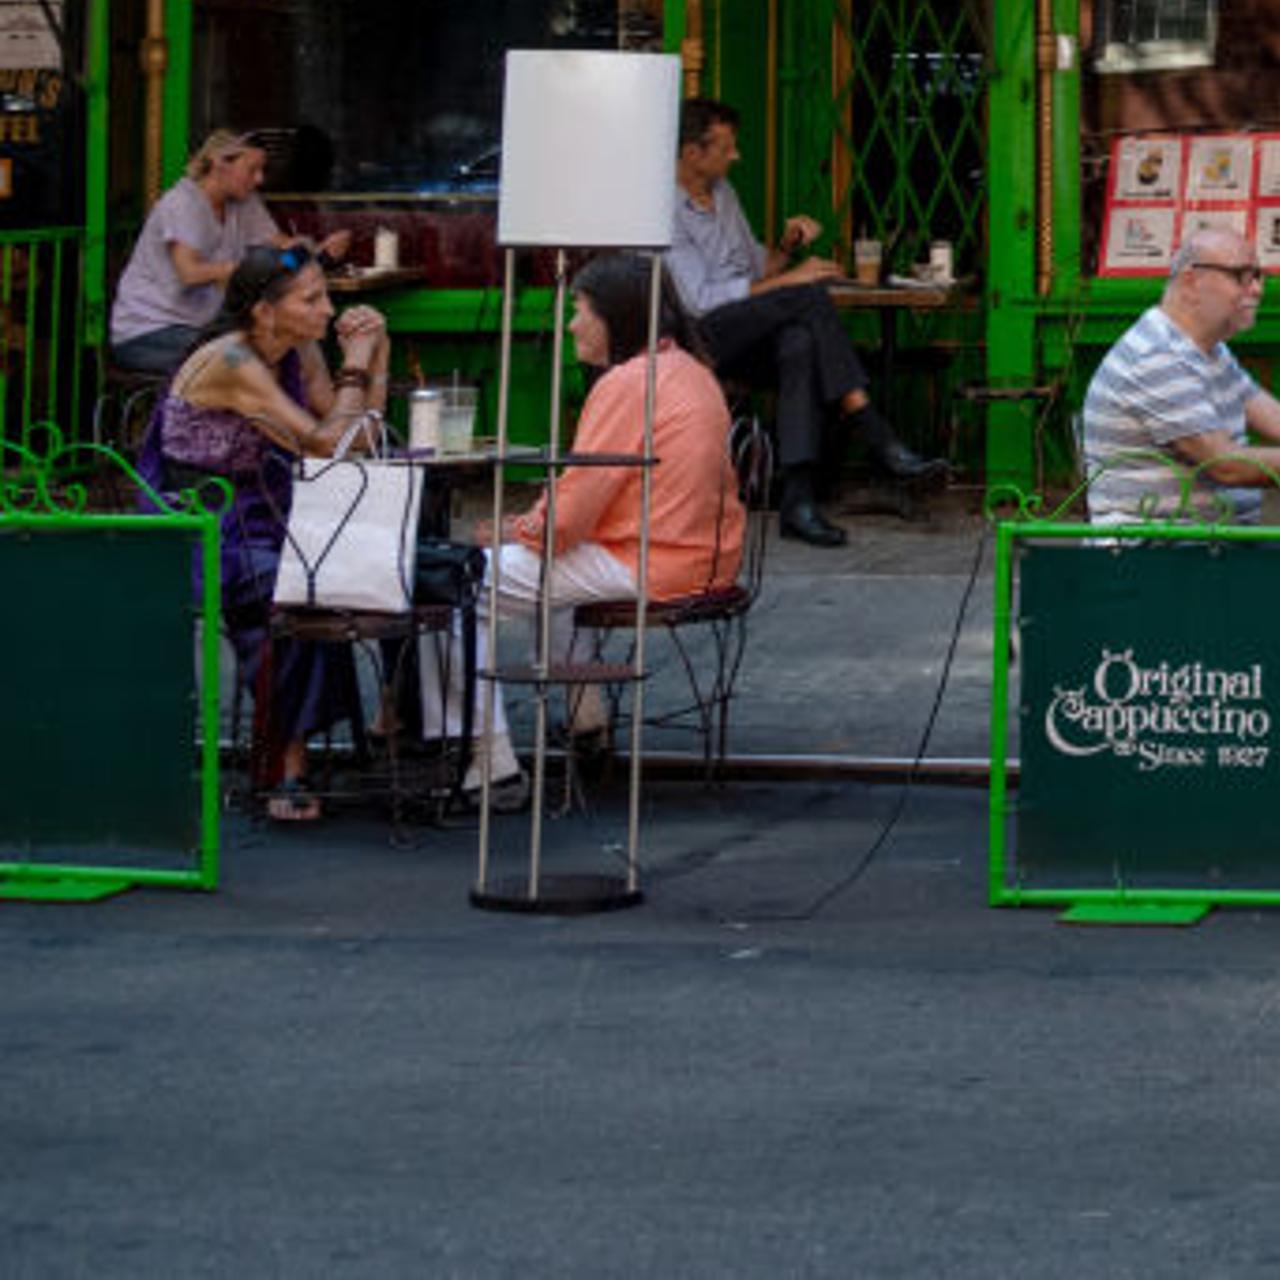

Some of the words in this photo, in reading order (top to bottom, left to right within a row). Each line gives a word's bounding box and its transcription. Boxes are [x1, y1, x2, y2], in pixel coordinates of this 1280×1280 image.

[1093, 648, 1263, 704] Original
[1045, 684, 1271, 756] Cappuccino
[1138, 740, 1205, 771] Since
